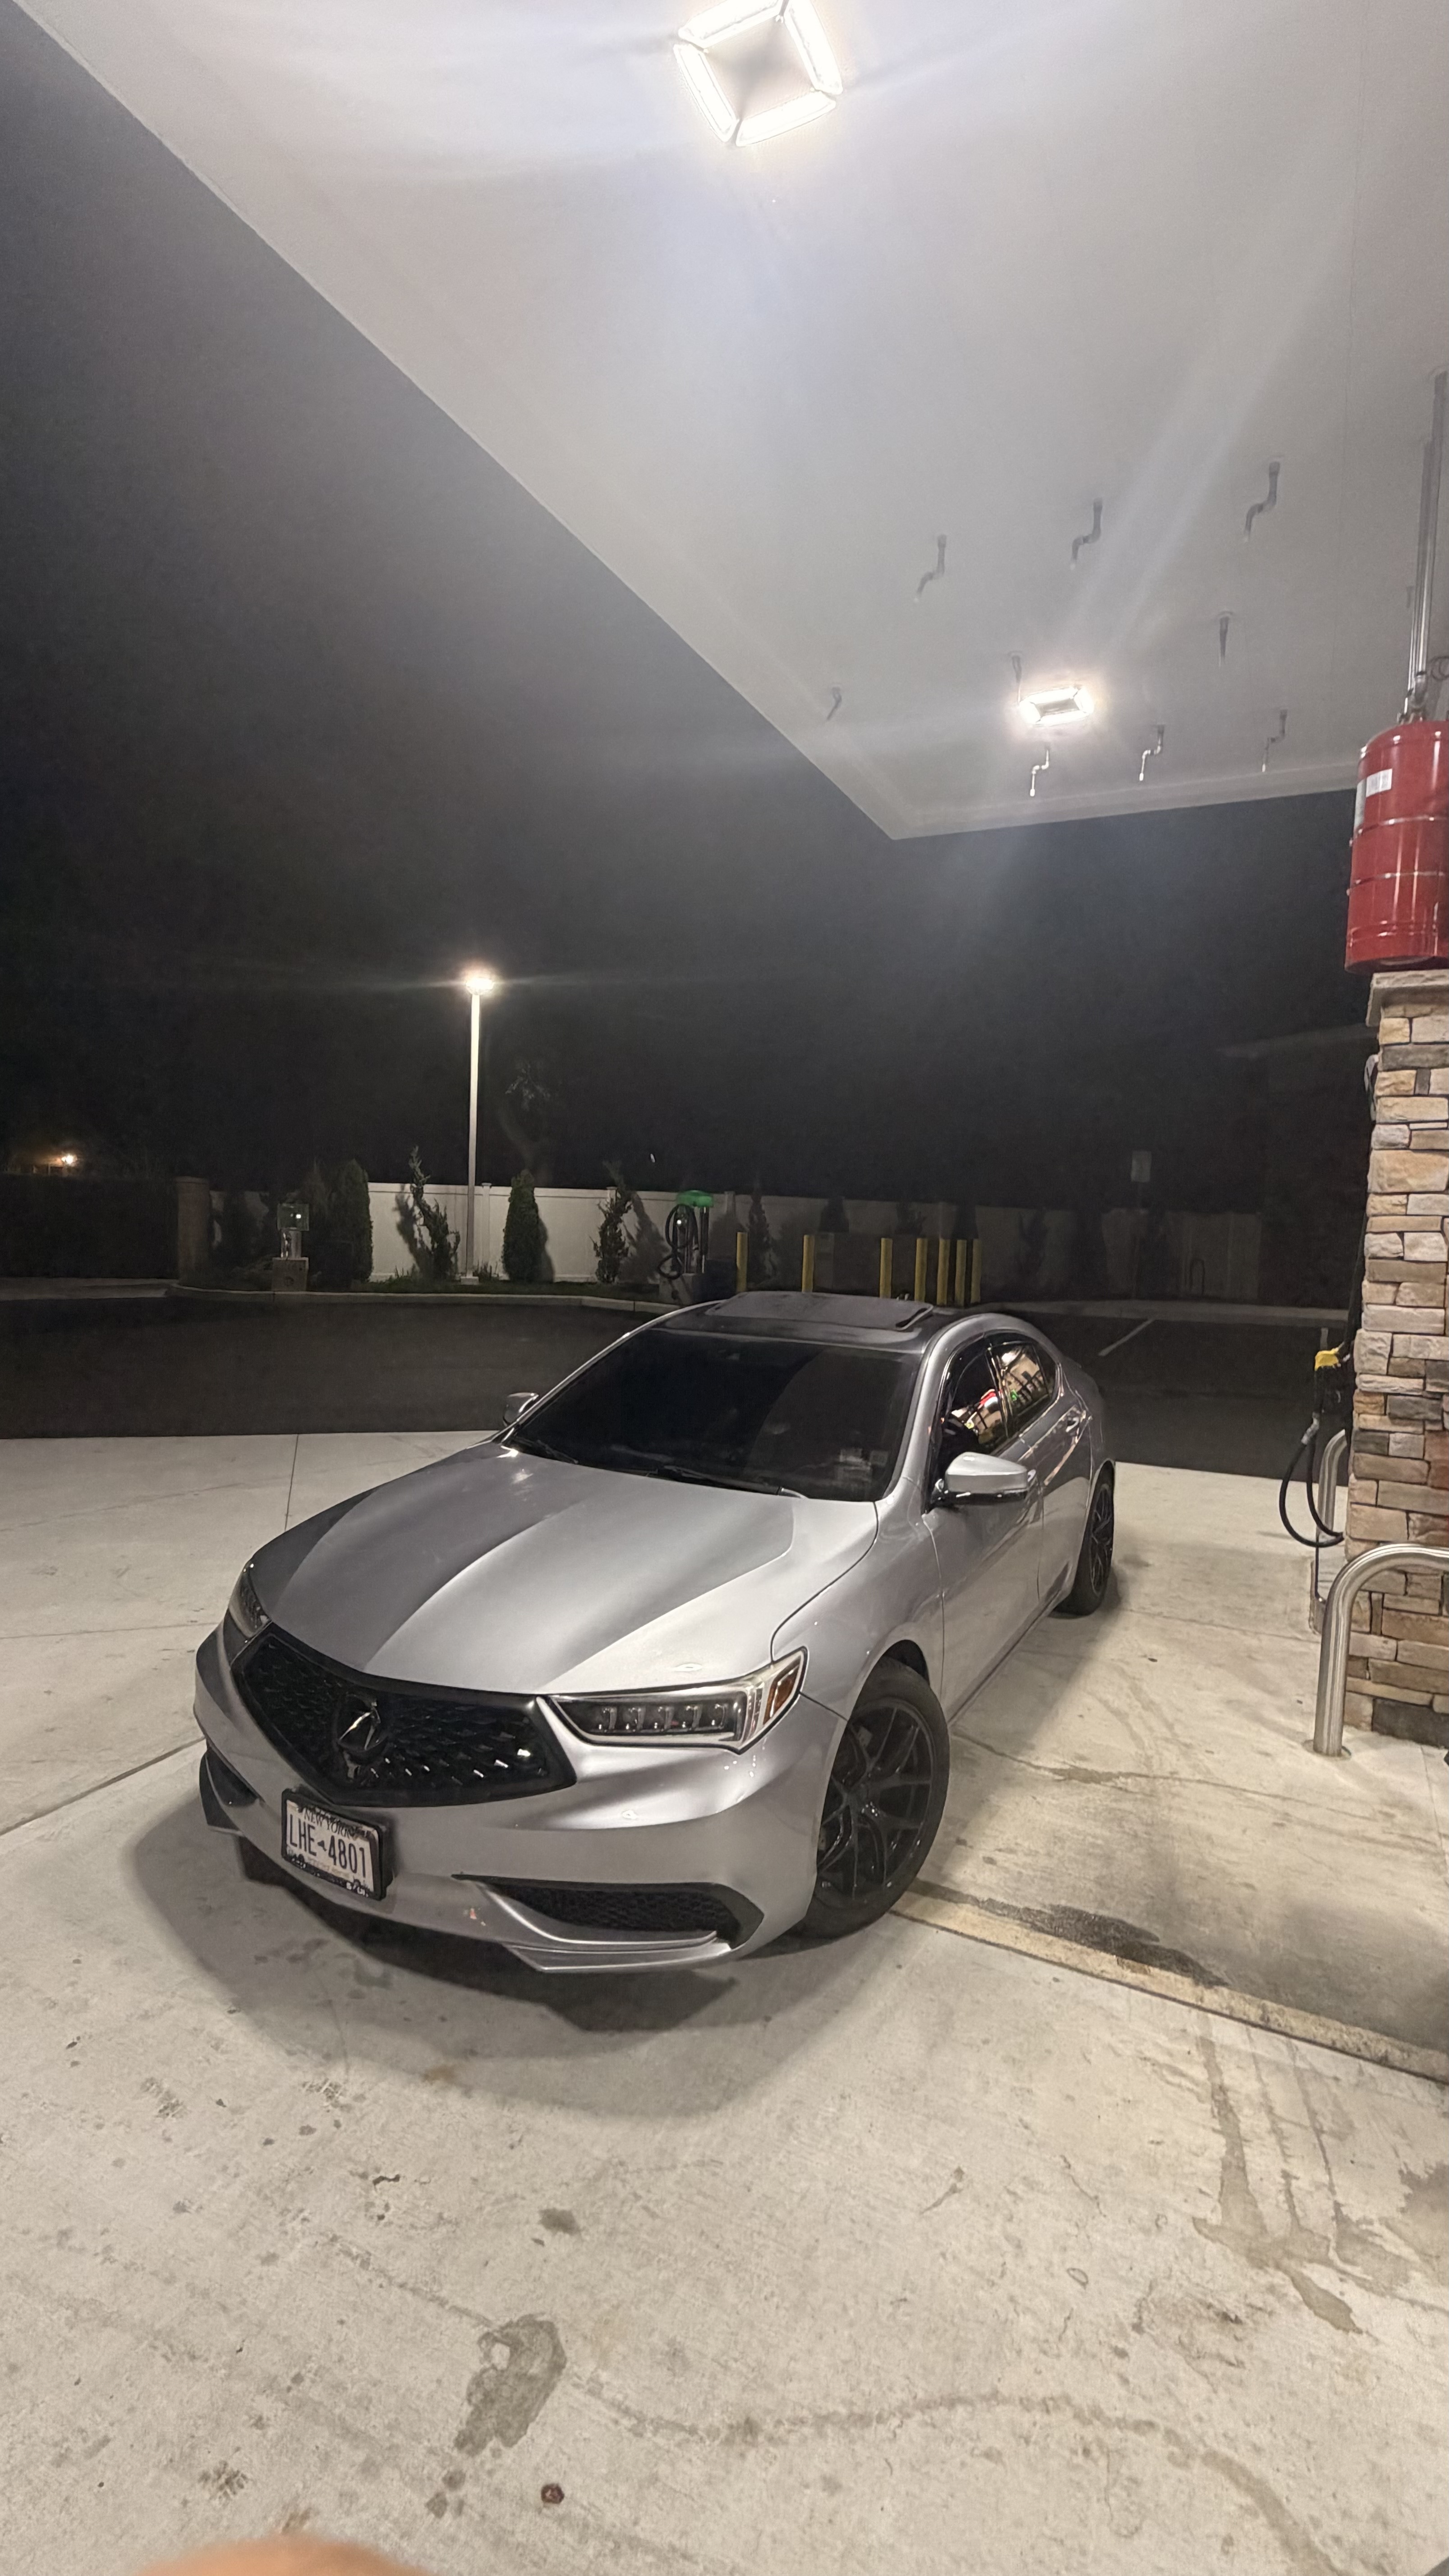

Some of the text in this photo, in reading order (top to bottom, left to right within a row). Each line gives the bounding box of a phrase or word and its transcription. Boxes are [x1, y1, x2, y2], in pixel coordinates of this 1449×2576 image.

[290, 1814, 317, 1856] LHE
[328, 1835, 366, 1878] 4801
[304, 1808, 350, 1839] NEW YORK
